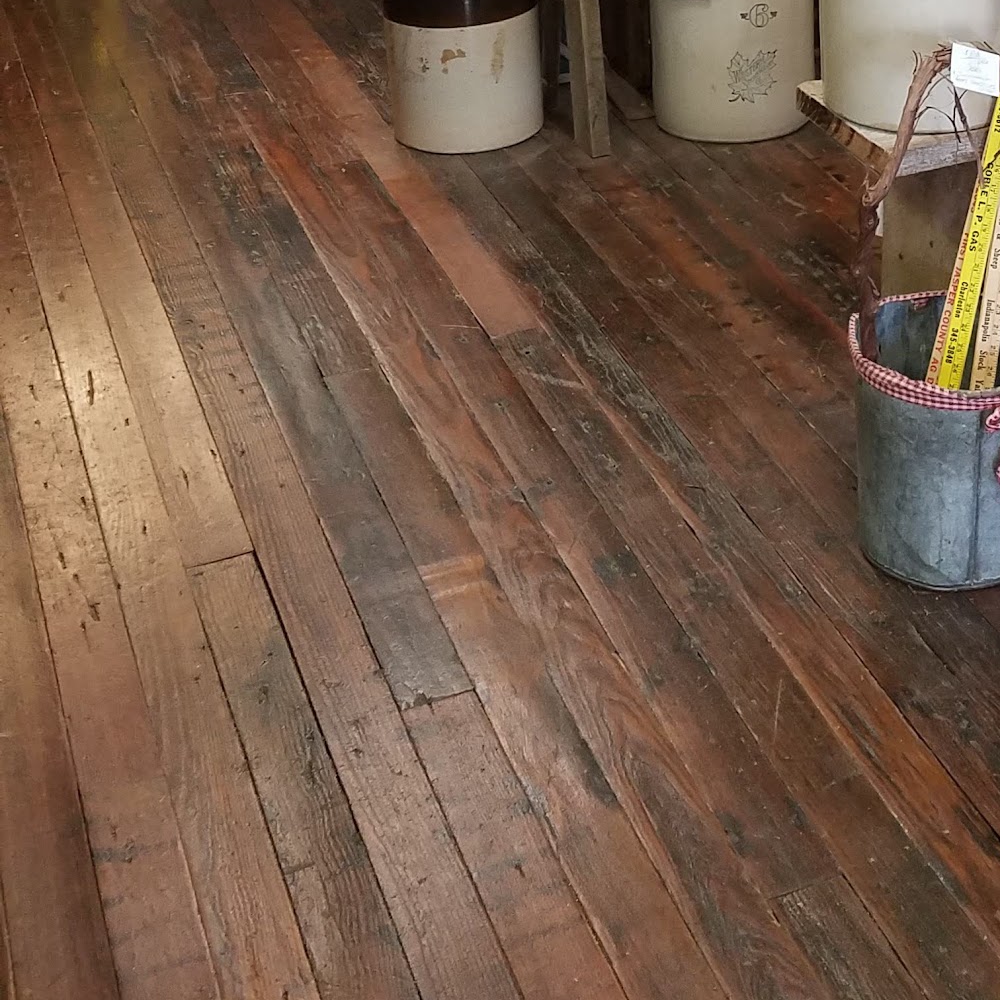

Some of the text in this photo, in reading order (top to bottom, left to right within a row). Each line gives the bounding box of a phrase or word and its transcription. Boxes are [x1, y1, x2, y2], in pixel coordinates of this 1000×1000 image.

[748, 2, 770, 29] 6
[969, 231, 980, 252] GAS
[947, 266, 962, 305] JASPER
[955, 281, 969, 318] Charleston
[935, 310, 951, 353] COUNTY
[982, 299, 996, 342] Indianapolis
[929, 357, 939, 372] AG
